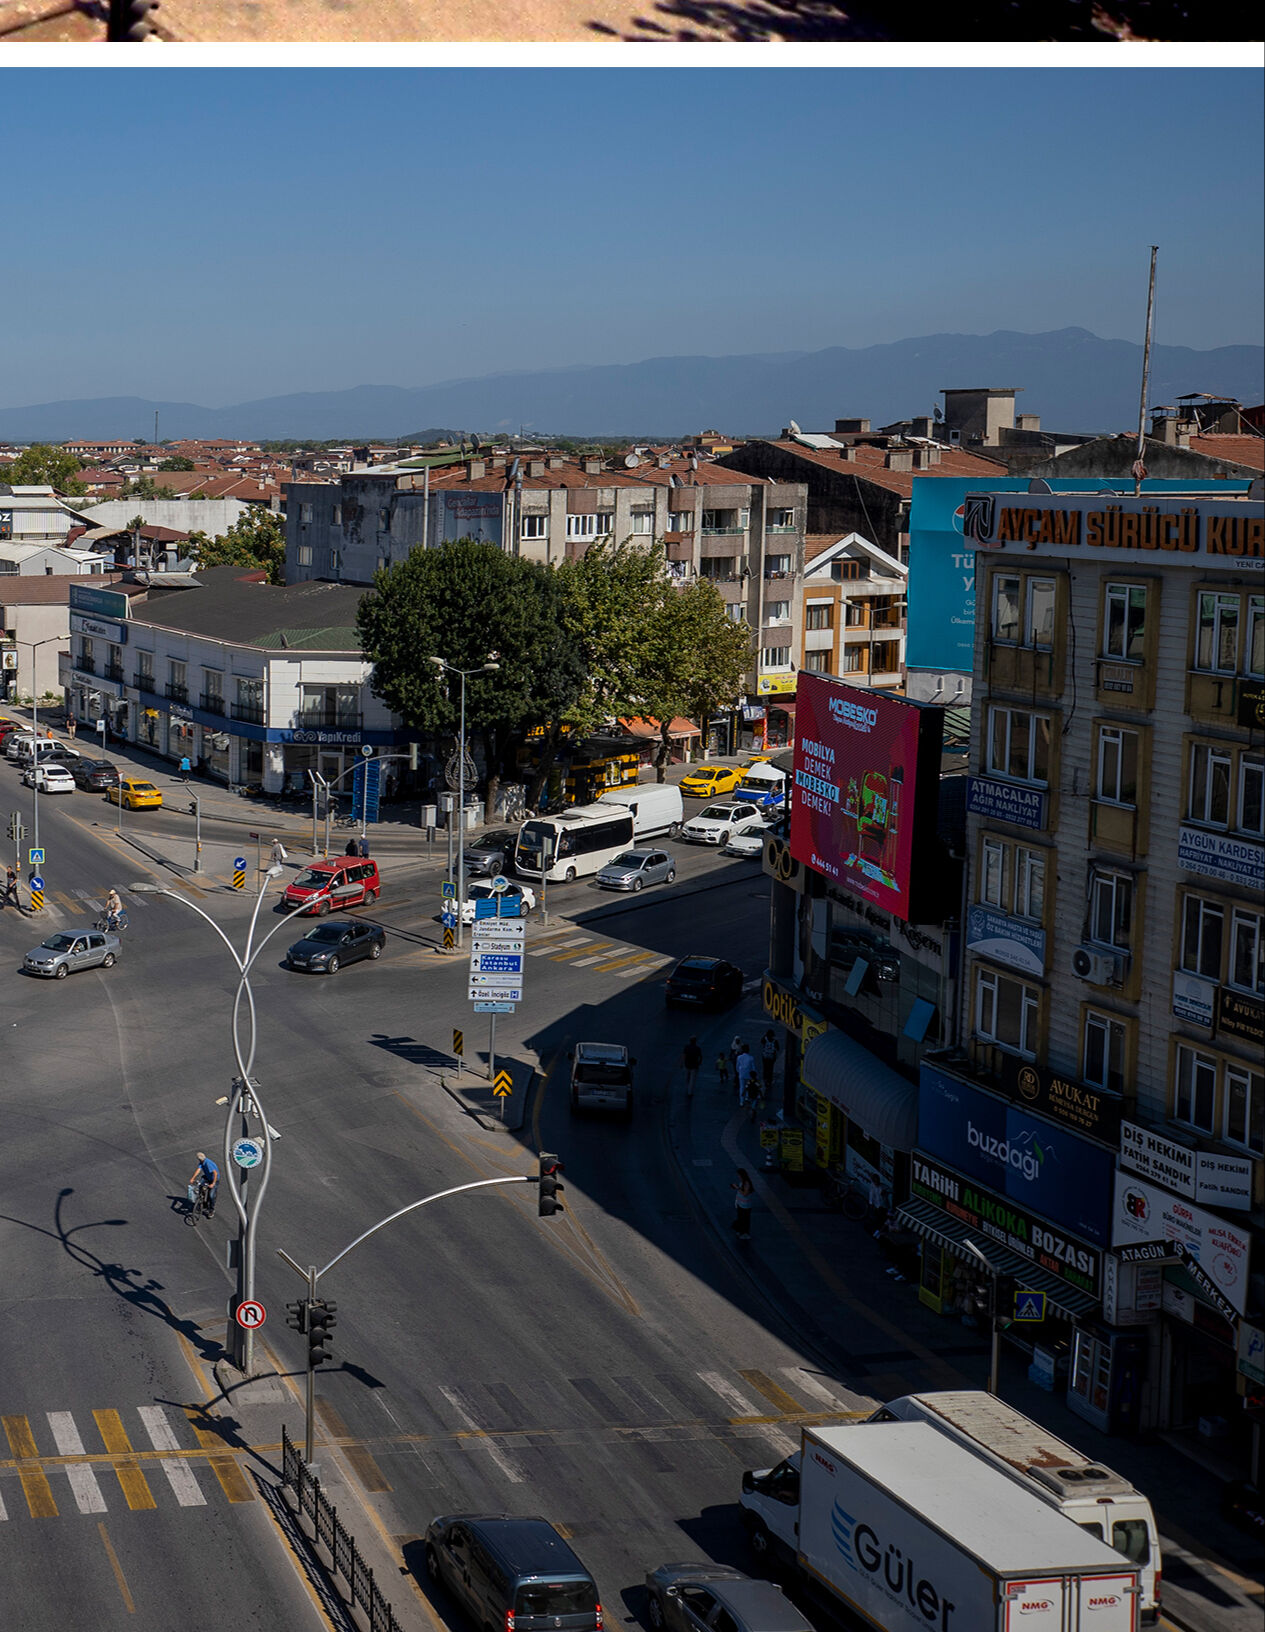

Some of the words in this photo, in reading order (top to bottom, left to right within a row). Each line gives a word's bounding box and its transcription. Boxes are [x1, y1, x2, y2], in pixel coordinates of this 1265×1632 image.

[997, 507, 1081, 550] AYÇAM
[1086, 505, 1199, 553] SÜRÜCÜ
[828, 696, 878, 727] MOBESKO
[801, 737, 836, 764] MOBİLYA
[804, 756, 832, 780] DEMEK
[797, 771, 837, 800] MOBESKO
[971, 780, 1040, 807] ATMACALAR
[801, 789, 832, 816] DEMEK!
[972, 793, 994, 807] AĞIR
[995, 799, 1039, 819] NAKLİYAT
[1181, 831, 1216, 851] AYGÜN
[764, 982, 797, 1029] Optik
[1049, 1078, 1101, 1111] AVUKAT
[967, 1120, 1040, 1182] buzdağı
[1123, 1126, 1144, 1149] DİŞ
[1147, 1136, 1192, 1169] HEKİMİ
[1123, 1145, 1151, 1166] FATİH
[1152, 1158, 1192, 1186] SANDIK
[1200, 1159, 1215, 1171] DİŞ
[1217, 1161, 1249, 1175] HEKİMİ
[1199, 1181, 1218, 1192] Fatih
[1219, 1185, 1250, 1197] SANDIK
[1031, 1224, 1096, 1278] BOZASI
[1121, 1244, 1166, 1263] ATAGÜN
[1186, 1259, 1238, 1322] MERKEZİ
[854, 1523, 956, 1632] Güler
[1021, 1601, 1049, 1610] NMG
[1089, 1596, 1116, 1606] NMG
